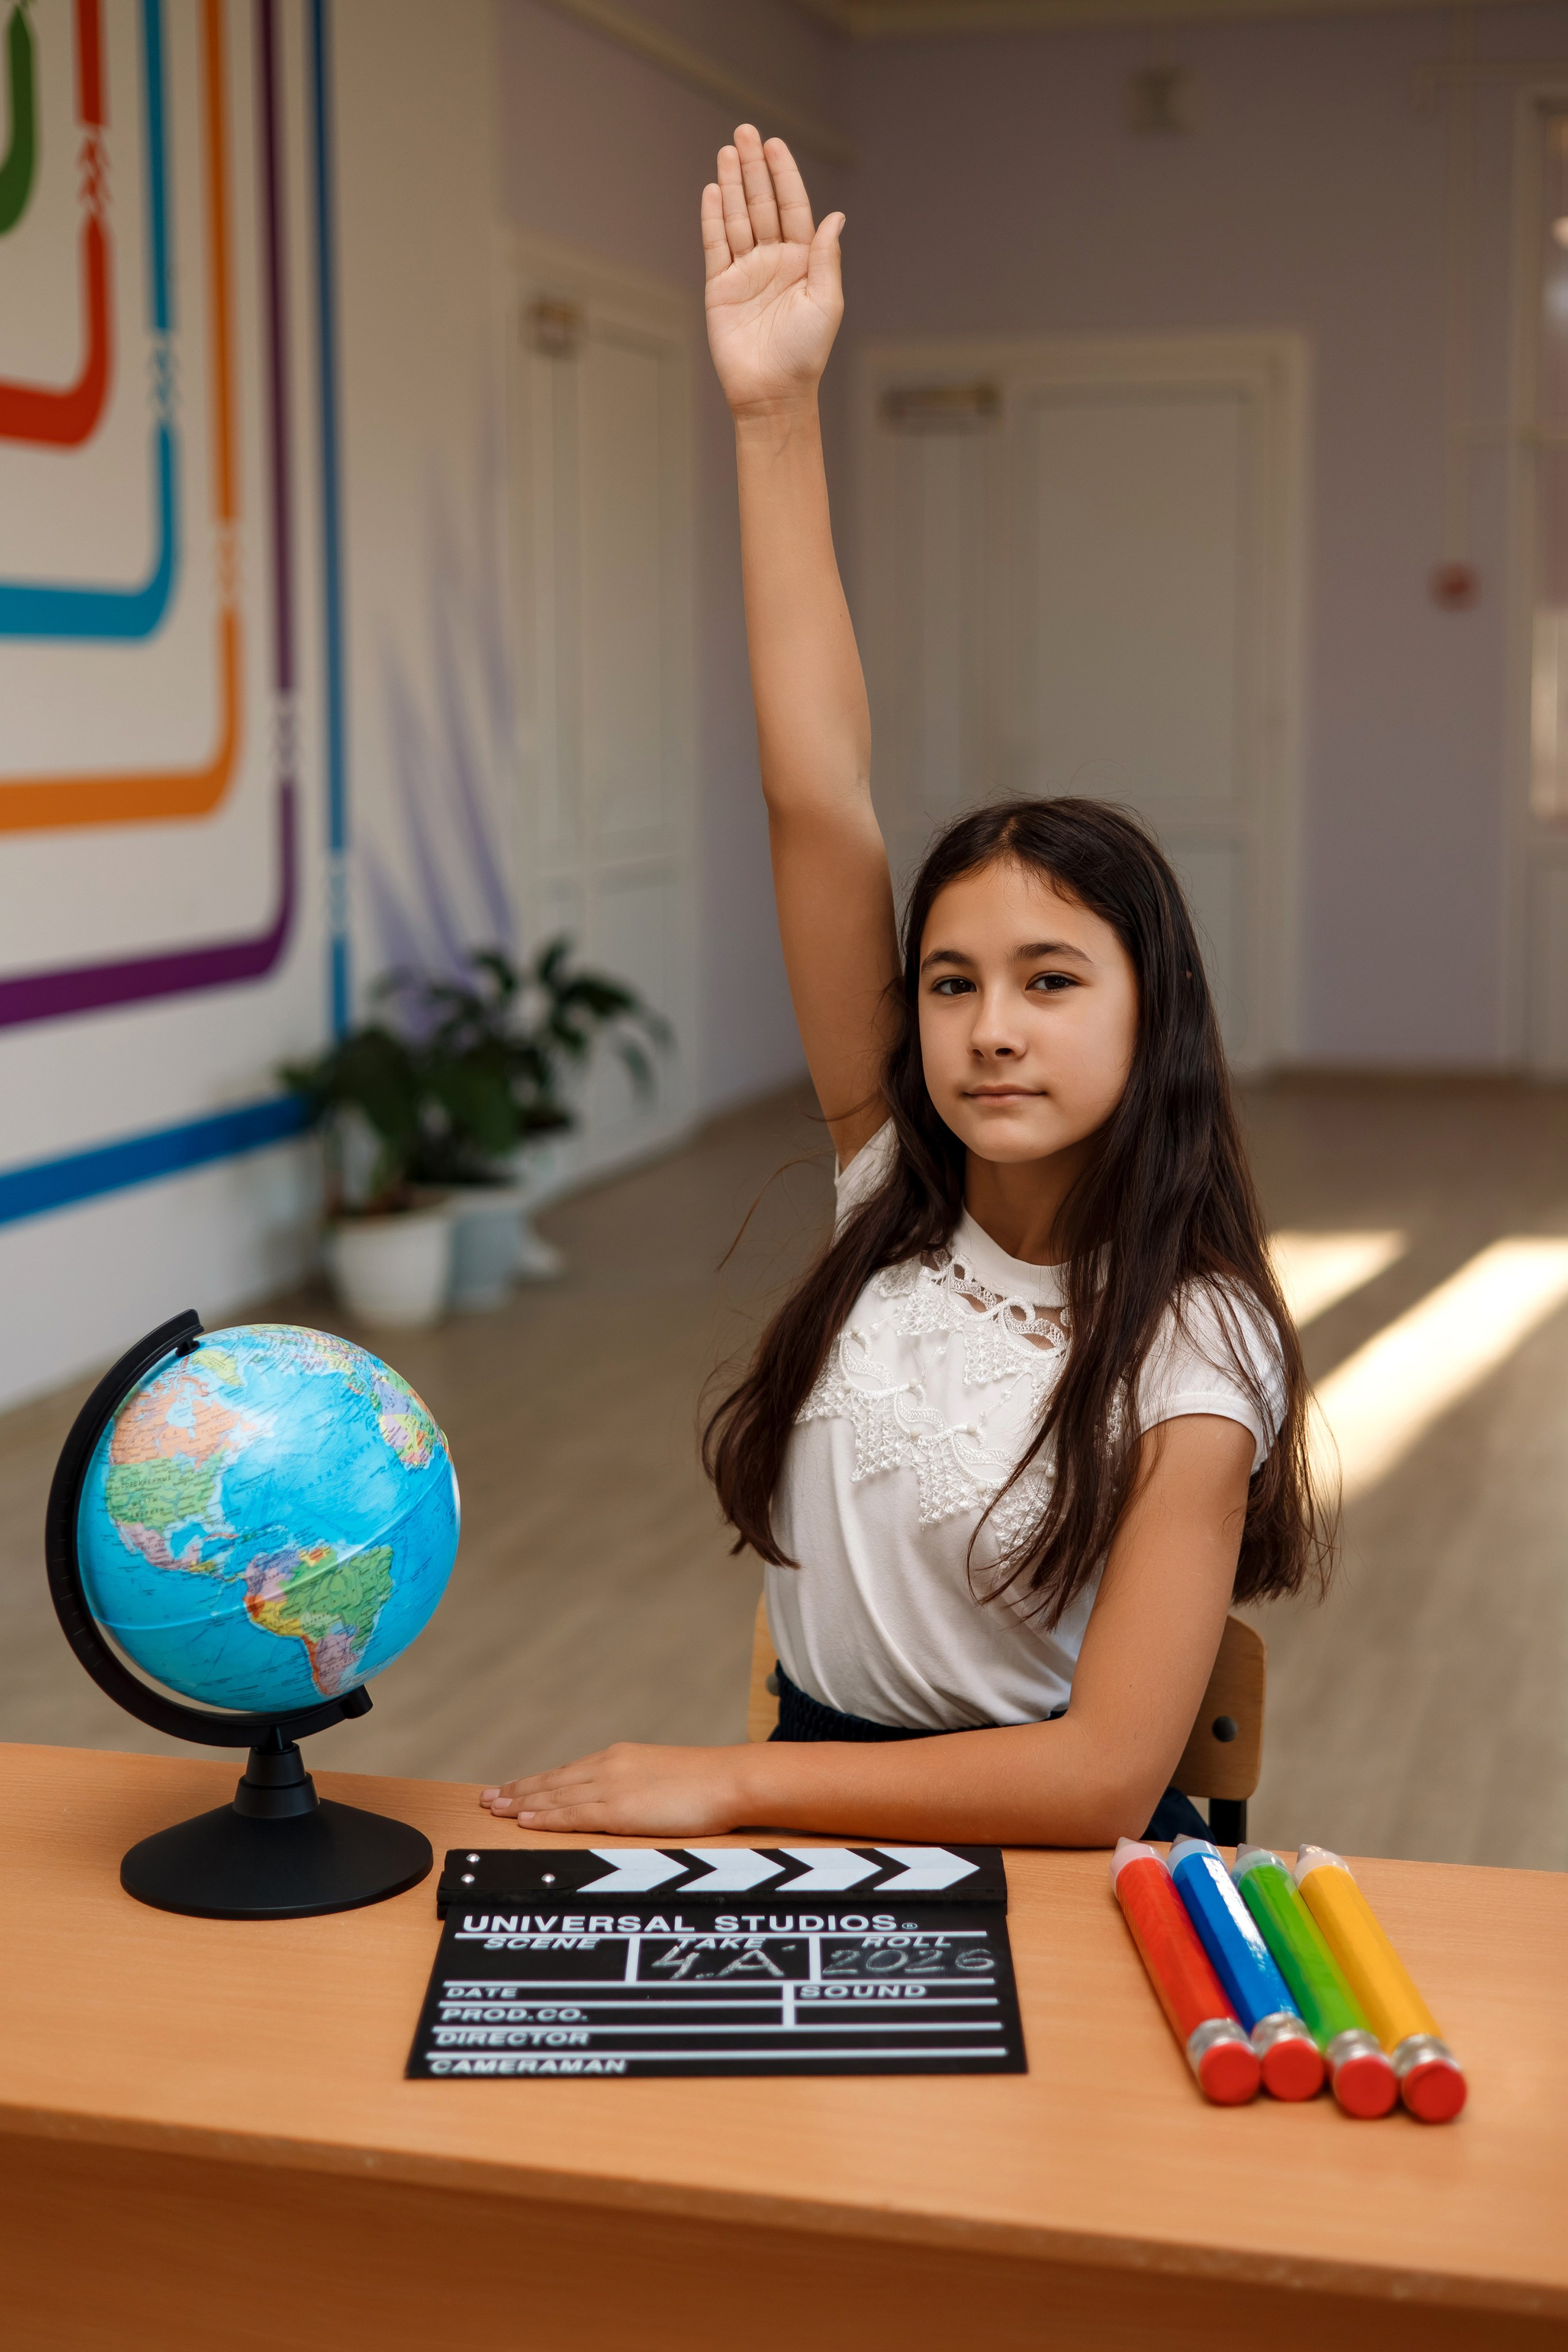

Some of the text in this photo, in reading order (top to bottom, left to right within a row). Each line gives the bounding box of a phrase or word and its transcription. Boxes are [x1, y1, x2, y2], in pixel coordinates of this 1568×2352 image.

[463, 1915, 695, 1932] UNIVERSAL
[483, 1937, 600, 1950] SCENE
[676, 1937, 766, 1950] TAKE
[861, 1936, 951, 1948] ROLL
[822, 1948, 995, 1975] 2026
[445, 1987, 519, 1999] DATE
[799, 1985, 927, 1999] SOUND
[440, 2008, 589, 2021] PROD.CO.
[434, 2031, 590, 2046] DIRECTOR
[430, 2059, 628, 2074] CAMERAMAN
